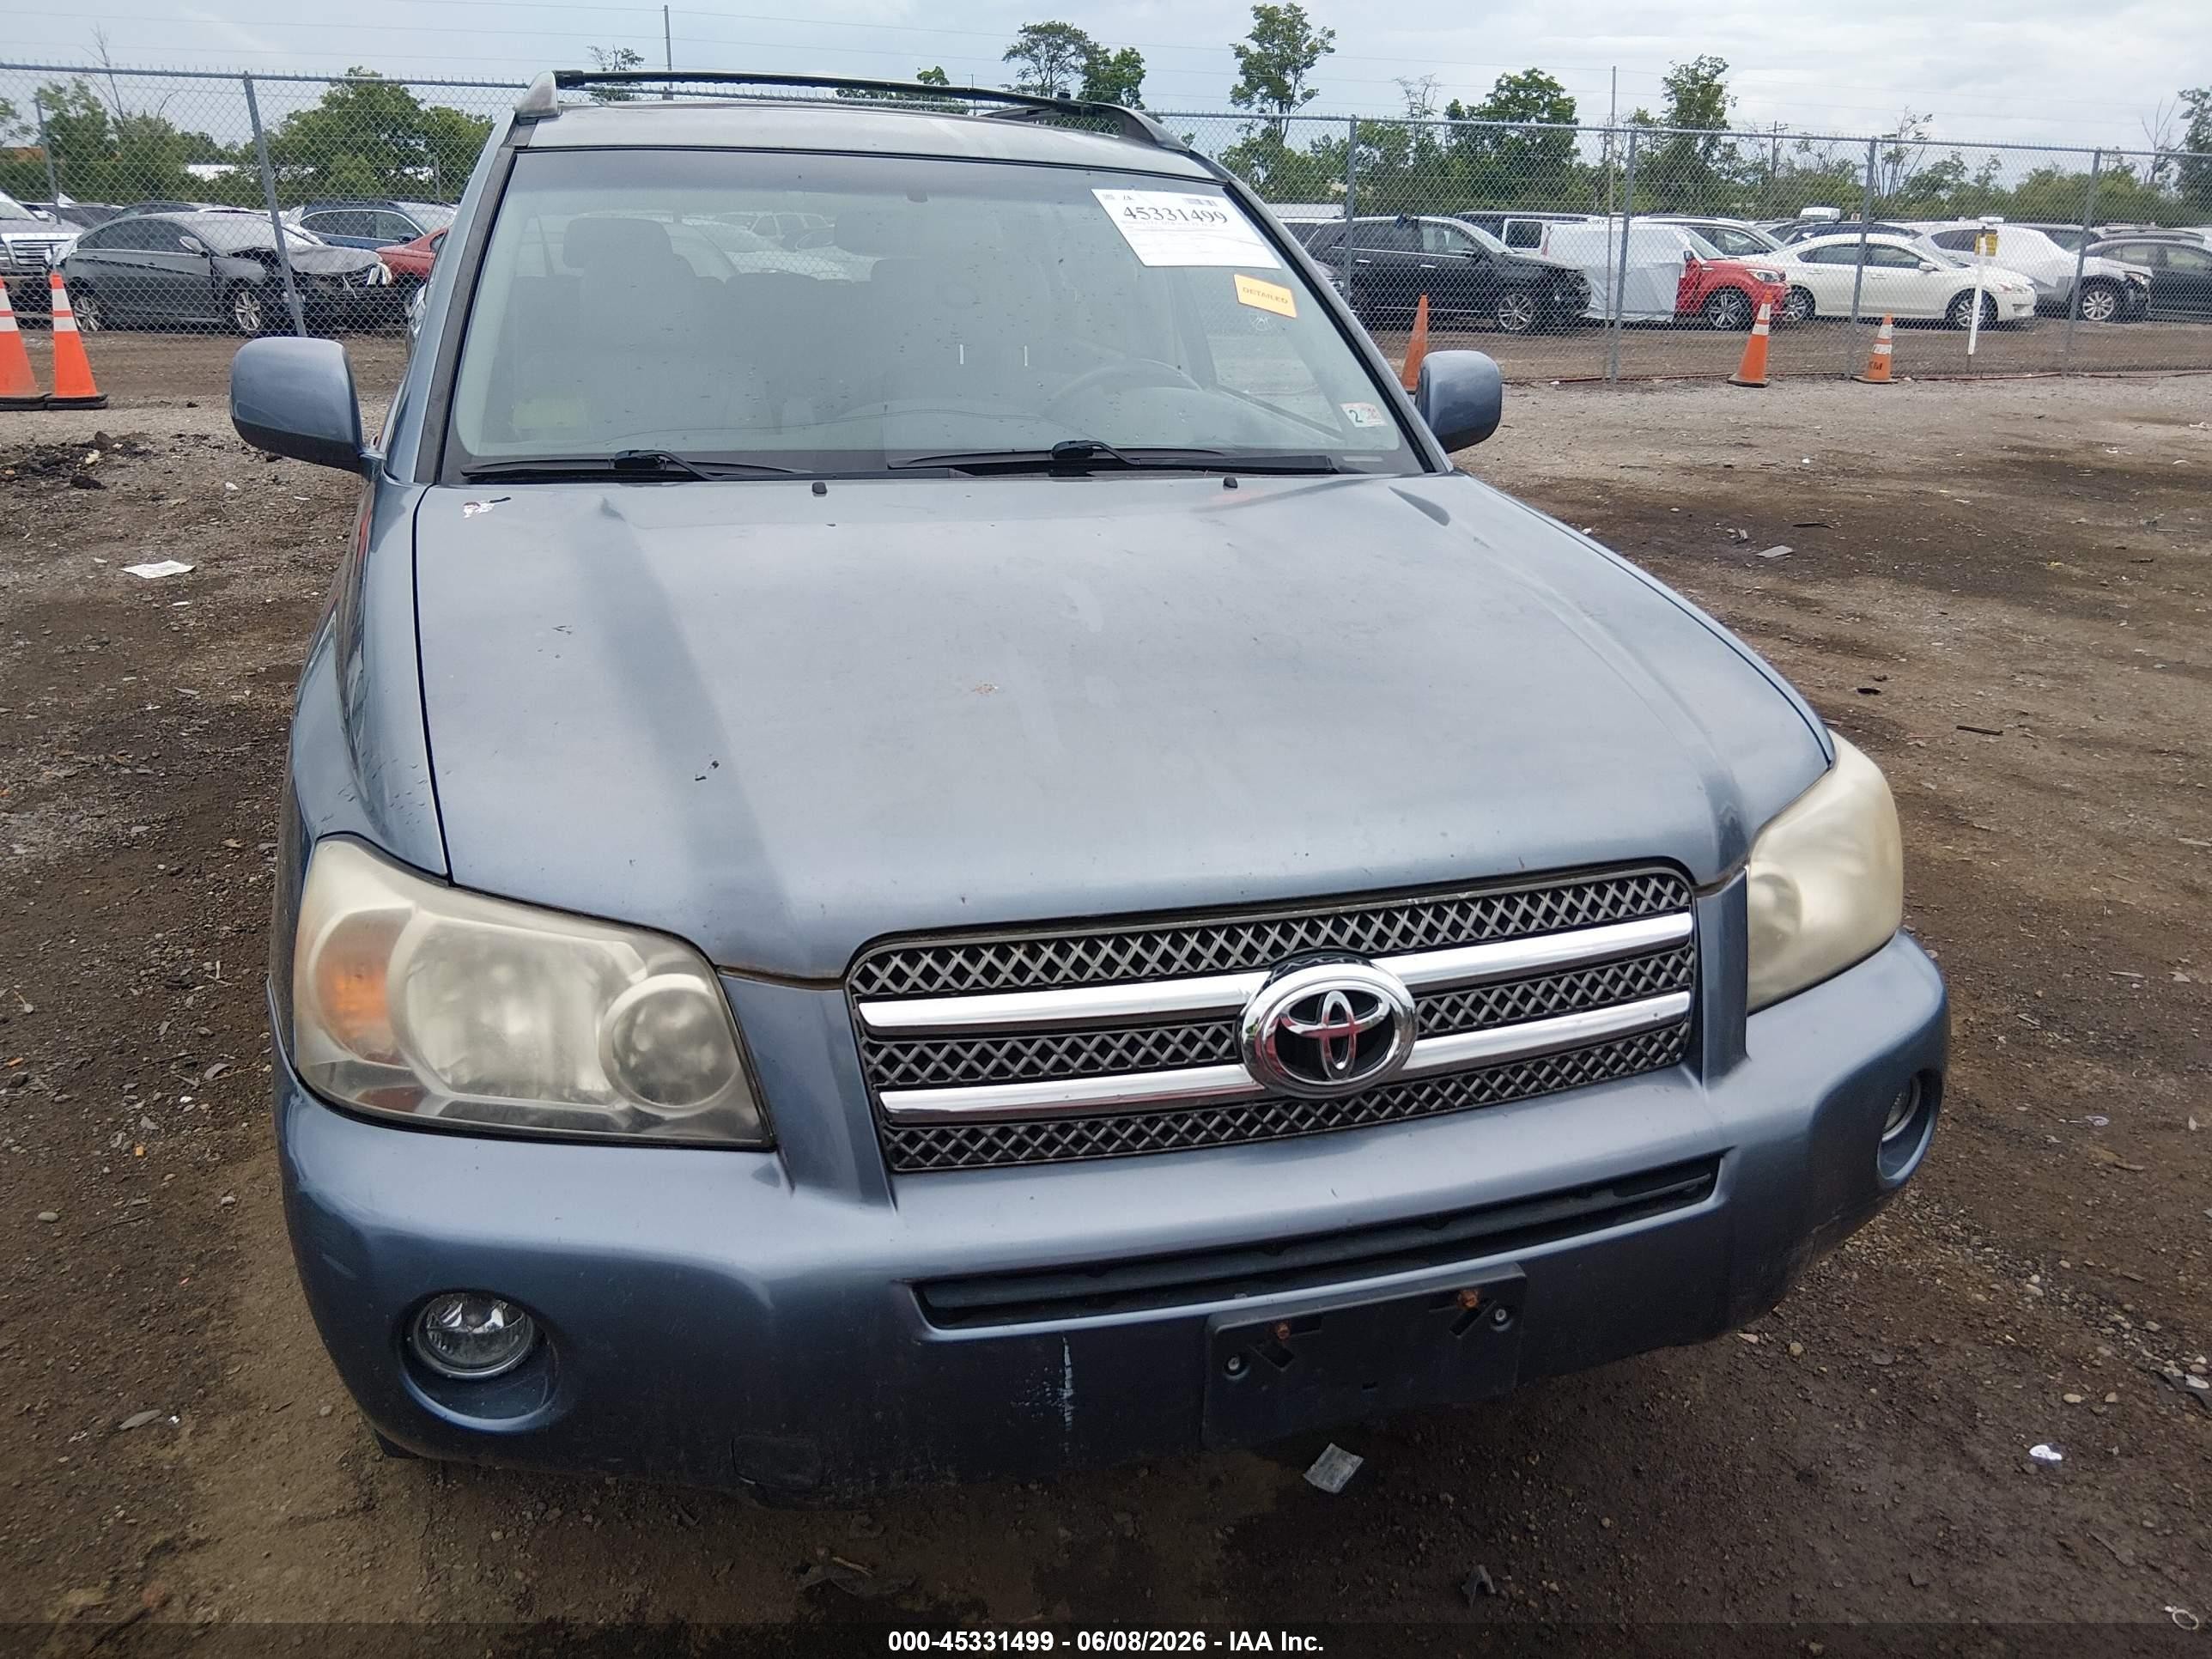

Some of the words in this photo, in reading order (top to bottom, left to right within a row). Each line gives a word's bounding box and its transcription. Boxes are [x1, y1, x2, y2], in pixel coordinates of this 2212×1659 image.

[1123, 206, 1228, 223] 45331499
[1243, 287, 1288, 304] DETAILED
[1348, 409, 1364, 422] 2
